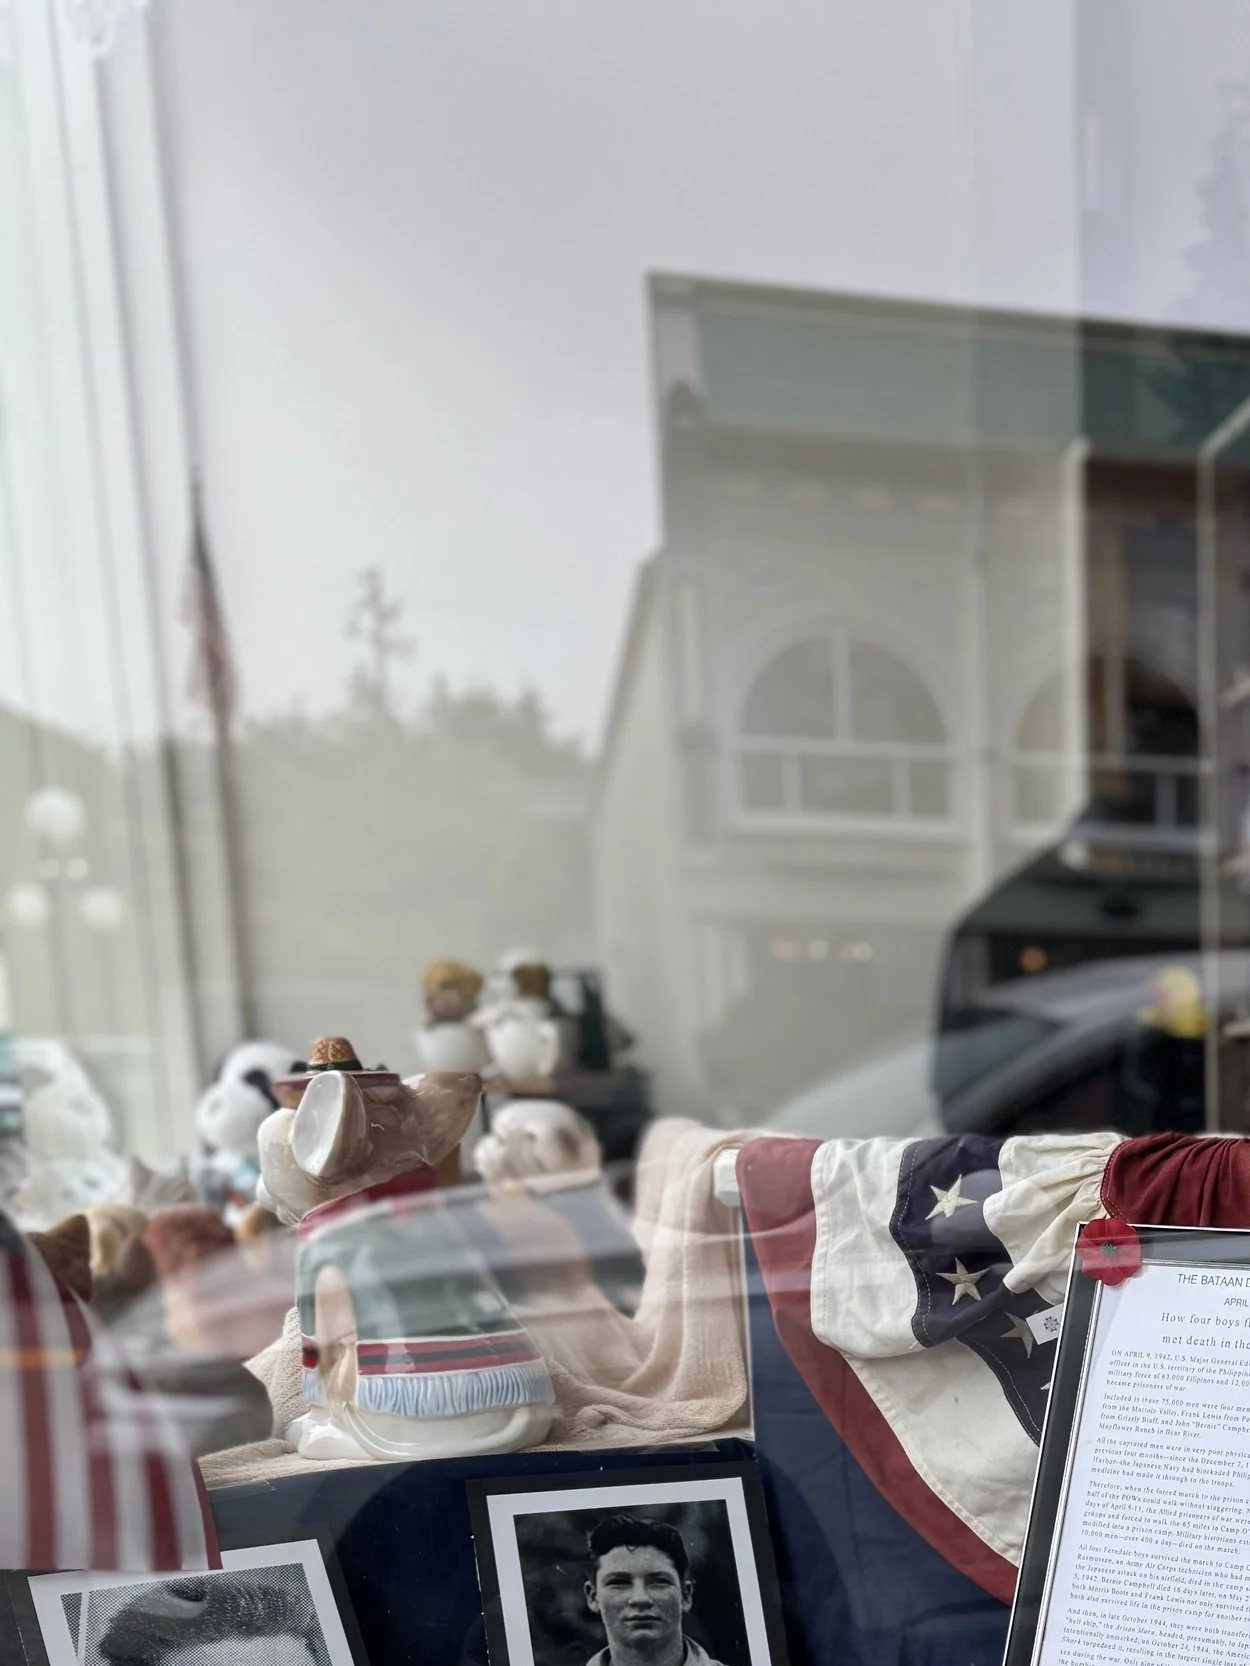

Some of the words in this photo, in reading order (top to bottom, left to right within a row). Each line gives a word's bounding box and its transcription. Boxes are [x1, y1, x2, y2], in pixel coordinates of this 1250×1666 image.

[1178, 1274, 1198, 1284] THE
[1201, 1275, 1243, 1287] BATAAN
[1224, 1298, 1249, 1307] APRIL
[1161, 1312, 1185, 1323] How
[1190, 1314, 1211, 1325] four
[1216, 1316, 1240, 1328] boys
[1163, 1336, 1182, 1344] met
[1187, 1336, 1216, 1347] death
[1221, 1338, 1230, 1348] in
[1235, 1339, 1250, 1349] the
[1124, 1350, 1144, 1358] APRIL
[1189, 1355, 1208, 1364] Major
[1211, 1357, 1237, 1365] General
[1167, 1363, 1195, 1373] territory
[1105, 1378, 1130, 1386] became
[1132, 1380, 1163, 1390] prisoners
[1107, 1368, 1132, 1378] military
[1186, 1375, 1214, 1385] Filipinos
[1083, 1511, 1105, 1519] groups
[1121, 1513, 1142, 1522] forced
[1152, 1517, 1167, 1525] walk
[1192, 1521, 1210, 1529] miles
[1220, 1525, 1239, 1535] Camp
[1074, 1562, 1085, 1570] the
[1087, 1564, 1115, 1575] Japanese
[1117, 1568, 1136, 1576] attack
[1188, 1577, 1202, 1585] died
[1212, 1580, 1223, 1588] the
[1225, 1584, 1243, 1592] camp
[1126, 1559, 1142, 1569] Army
[1156, 1563, 1176, 1573] Corps
[1178, 1565, 1212, 1576] technician
[1214, 1570, 1228, 1578] who
[1230, 1572, 1242, 1580] had
